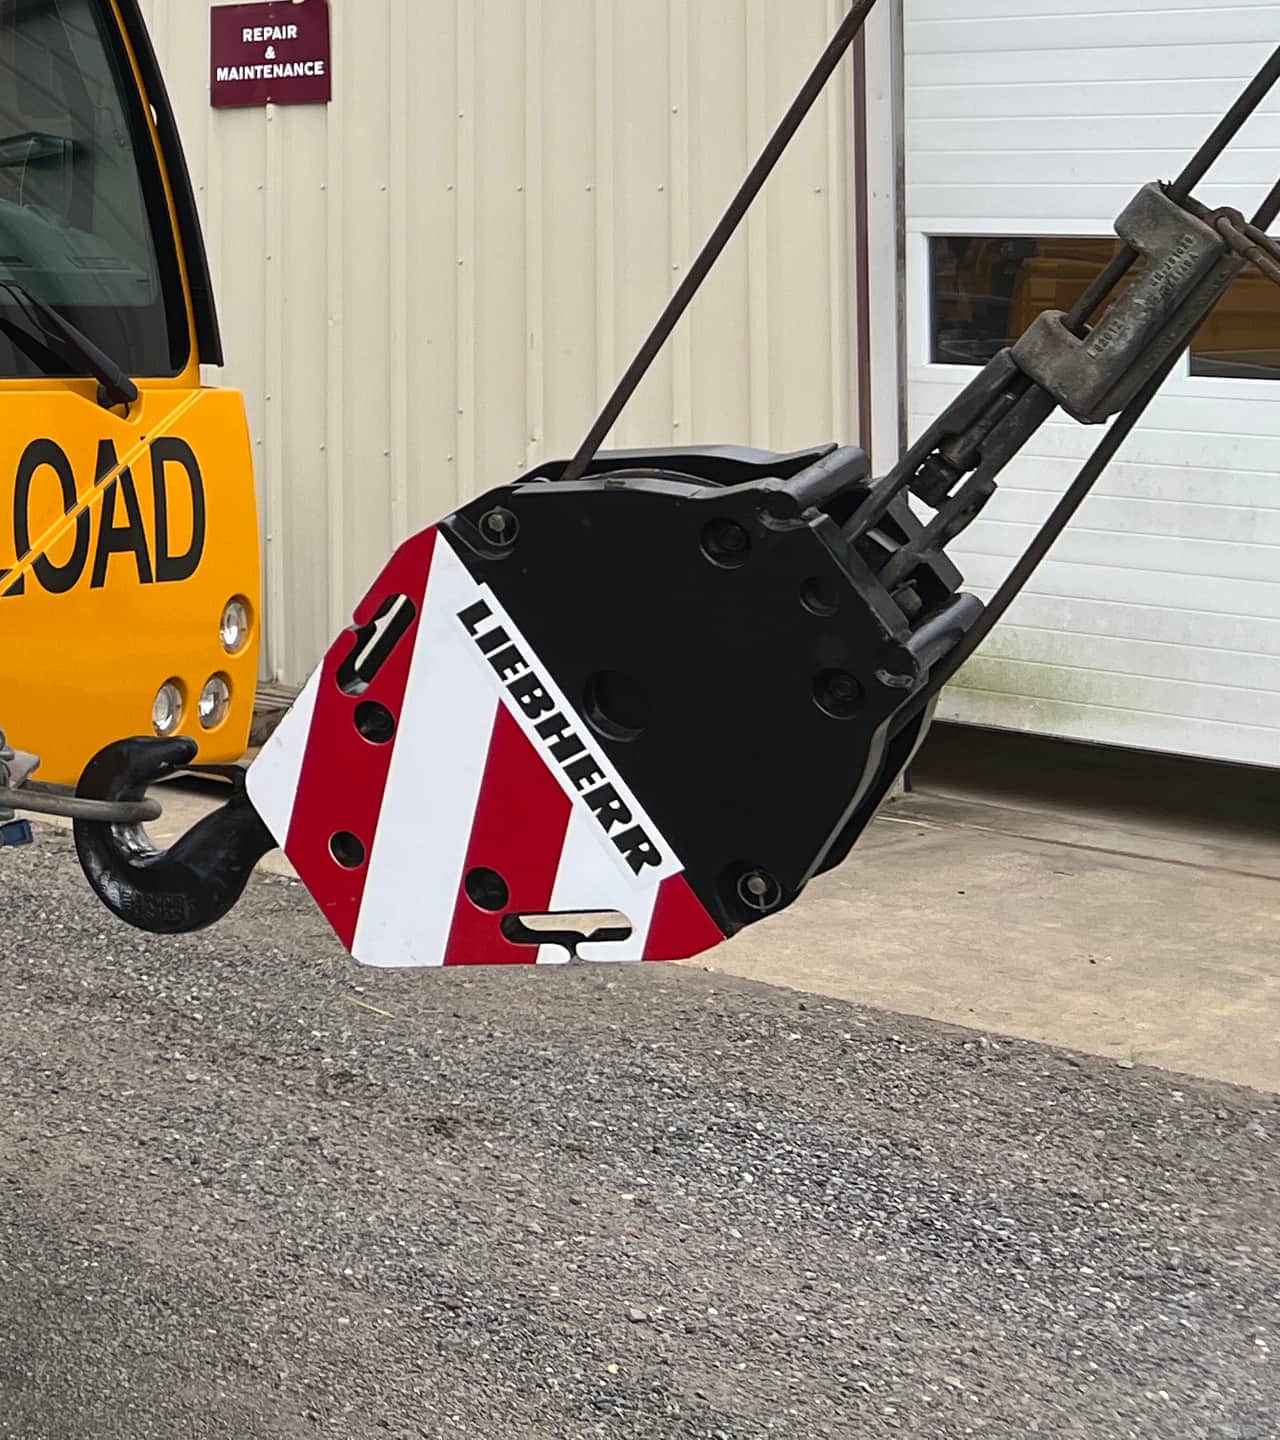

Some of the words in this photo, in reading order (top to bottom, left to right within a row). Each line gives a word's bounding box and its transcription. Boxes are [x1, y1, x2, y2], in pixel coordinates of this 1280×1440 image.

[242, 24, 298, 43] REPAIR
[264, 45, 276, 60] &
[216, 60, 325, 82] MAINTENANCE
[456, 600, 663, 877] LIEBHERR
